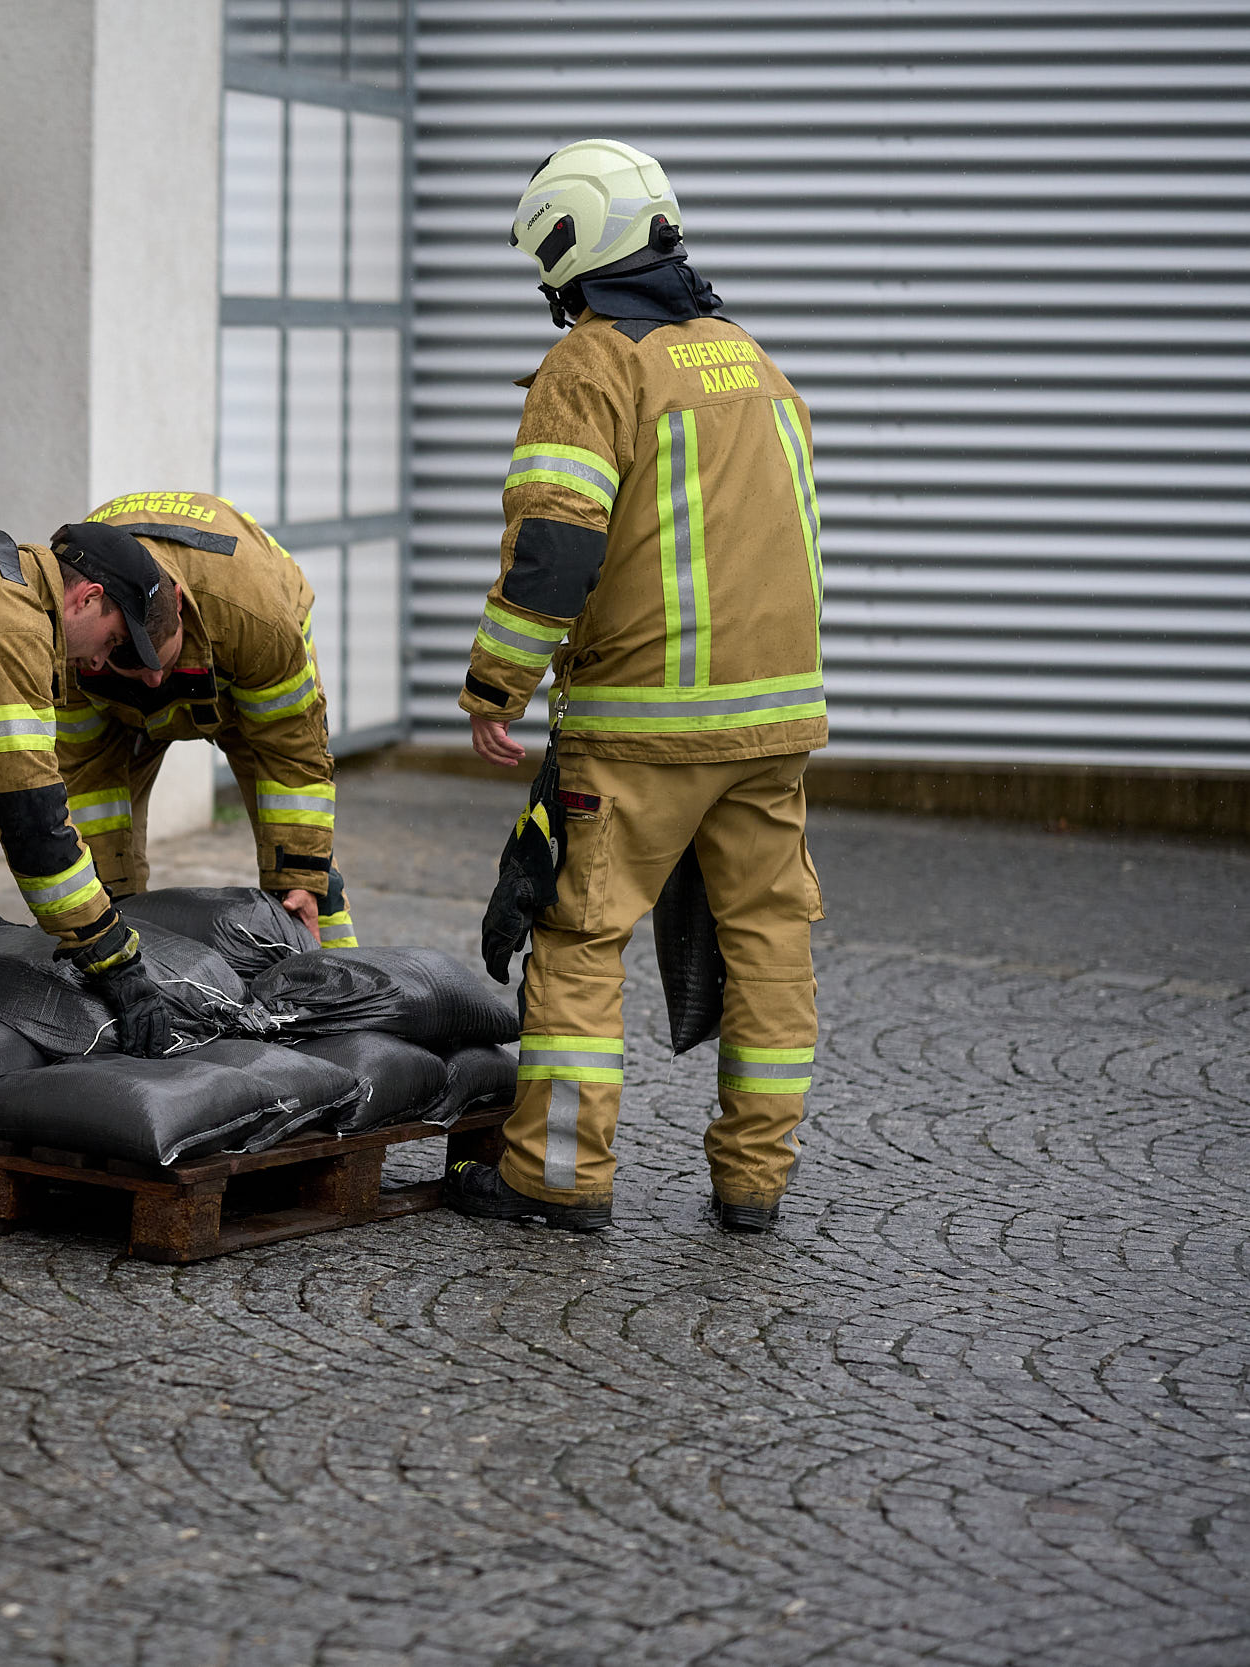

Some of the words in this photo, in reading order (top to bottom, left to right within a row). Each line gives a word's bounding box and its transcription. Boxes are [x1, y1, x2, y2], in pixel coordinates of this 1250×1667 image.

[527, 207, 545, 230] JORDAN
[666, 340, 761, 368] FEUERWEHR
[699, 365, 760, 393] AXAMS
